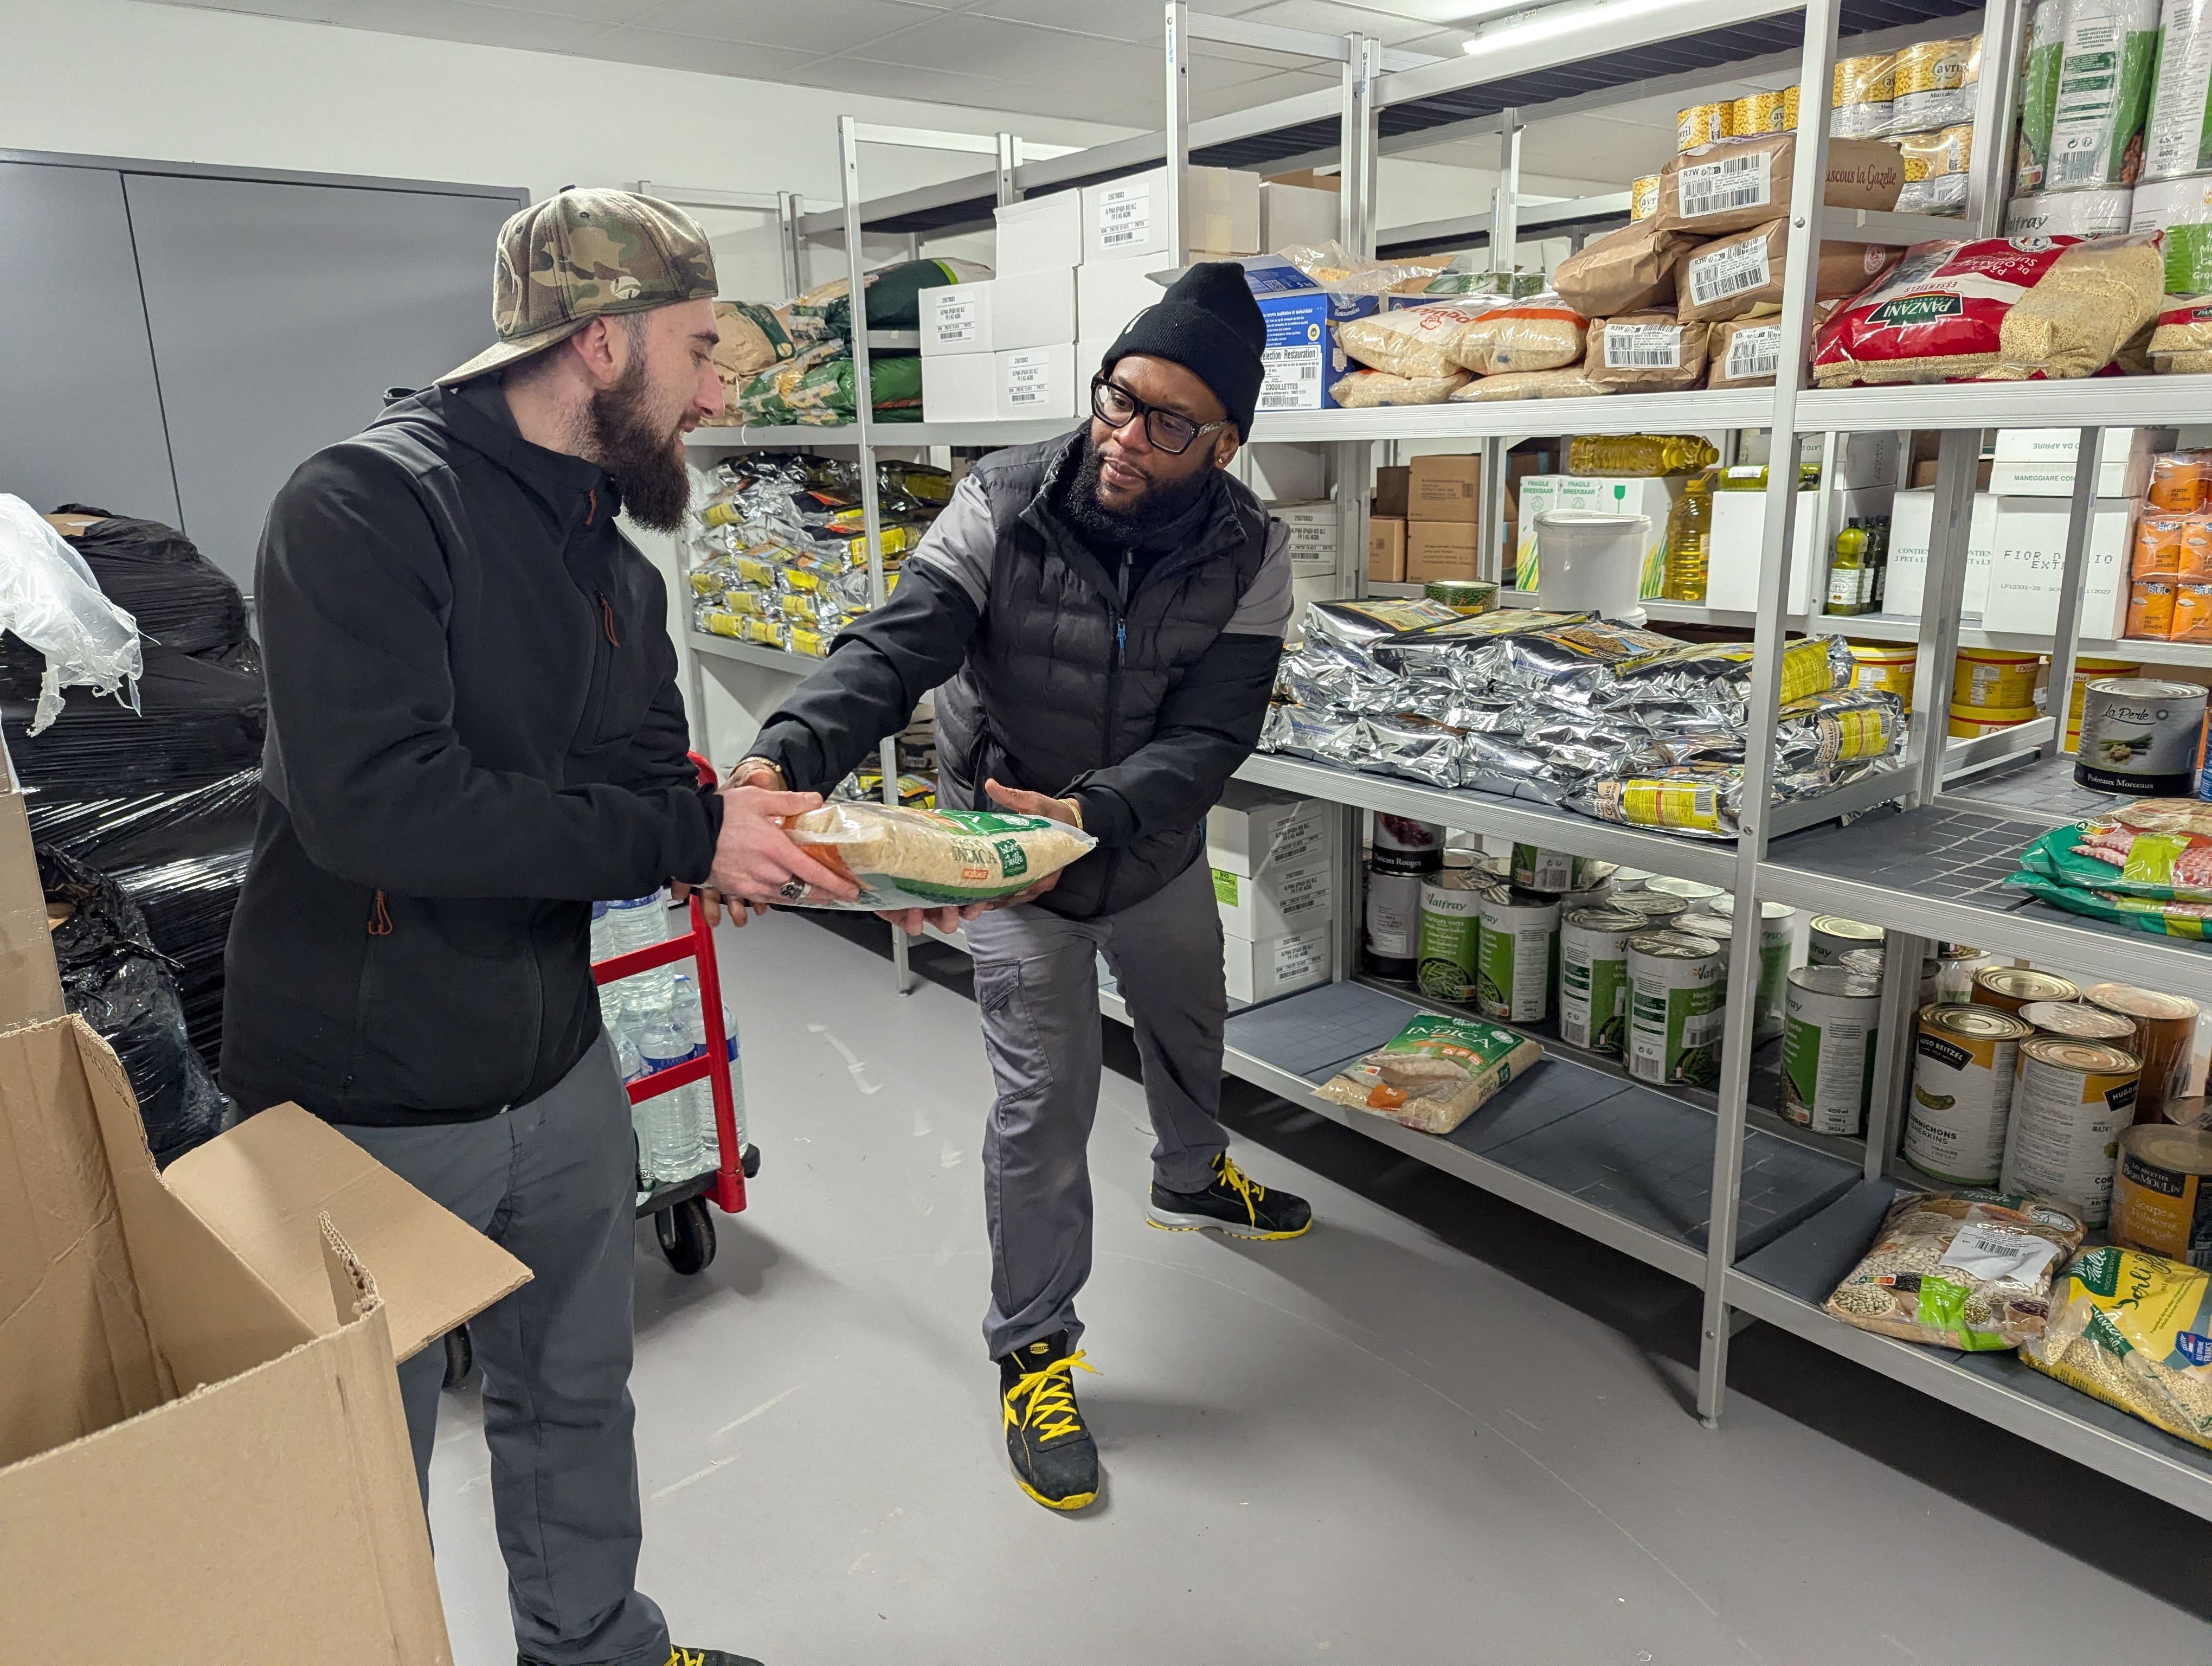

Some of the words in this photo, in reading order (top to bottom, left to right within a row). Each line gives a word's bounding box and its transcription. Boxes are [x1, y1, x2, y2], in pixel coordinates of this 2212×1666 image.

[1683, 169, 1699, 177] R7W
[1825, 167, 1856, 184] uscous
[1857, 164, 1866, 182] la
[1867, 164, 1896, 192] Gazelle
[2007, 214, 2049, 230] alfray
[1694, 257, 1708, 266] R3W
[2017, 265, 2030, 275] DE
[1904, 281, 1958, 293] ESSENTIELS
[1888, 295, 1955, 306] Professionnel
[1334, 307, 1360, 317] Restauration
[1883, 300, 1952, 318] PANZANI
[1284, 349, 1316, 360] Restauration
[1265, 383, 1298, 391] COQUILLETTES
[2004, 550, 2042, 560] FIOR
[2101, 704, 2116, 717] La
[2119, 708, 2149, 720] Perle
[1824, 722, 1834, 760] Céréales
[2087, 773, 2114, 785] Poireaux
[2116, 779, 2154, 789] Morceaux
[1604, 785, 1612, 816] Céréales
[951, 845, 998, 864] INDICA
[1396, 858, 1422, 868] Rouges
[1219, 876, 1236, 886] FRANCE
[1405, 1026, 1491, 1049] INDICA
[1935, 1042, 1964, 1061] REITZEL
[2112, 1088, 2132, 1100] HUGO
[1908, 1112, 1957, 1140] CORNICHONS
[1911, 1122, 1949, 1145] GHERKINS
[2136, 1199, 2168, 1216] Soupe
[2132, 1207, 2177, 1229] Poissons
[2087, 1248, 2107, 1284] Paille
[2107, 1249, 2118, 1274] SERVICE
[2104, 1274, 2112, 1291] FOOD
[2203, 1342, 2212, 1362] FRANCE
